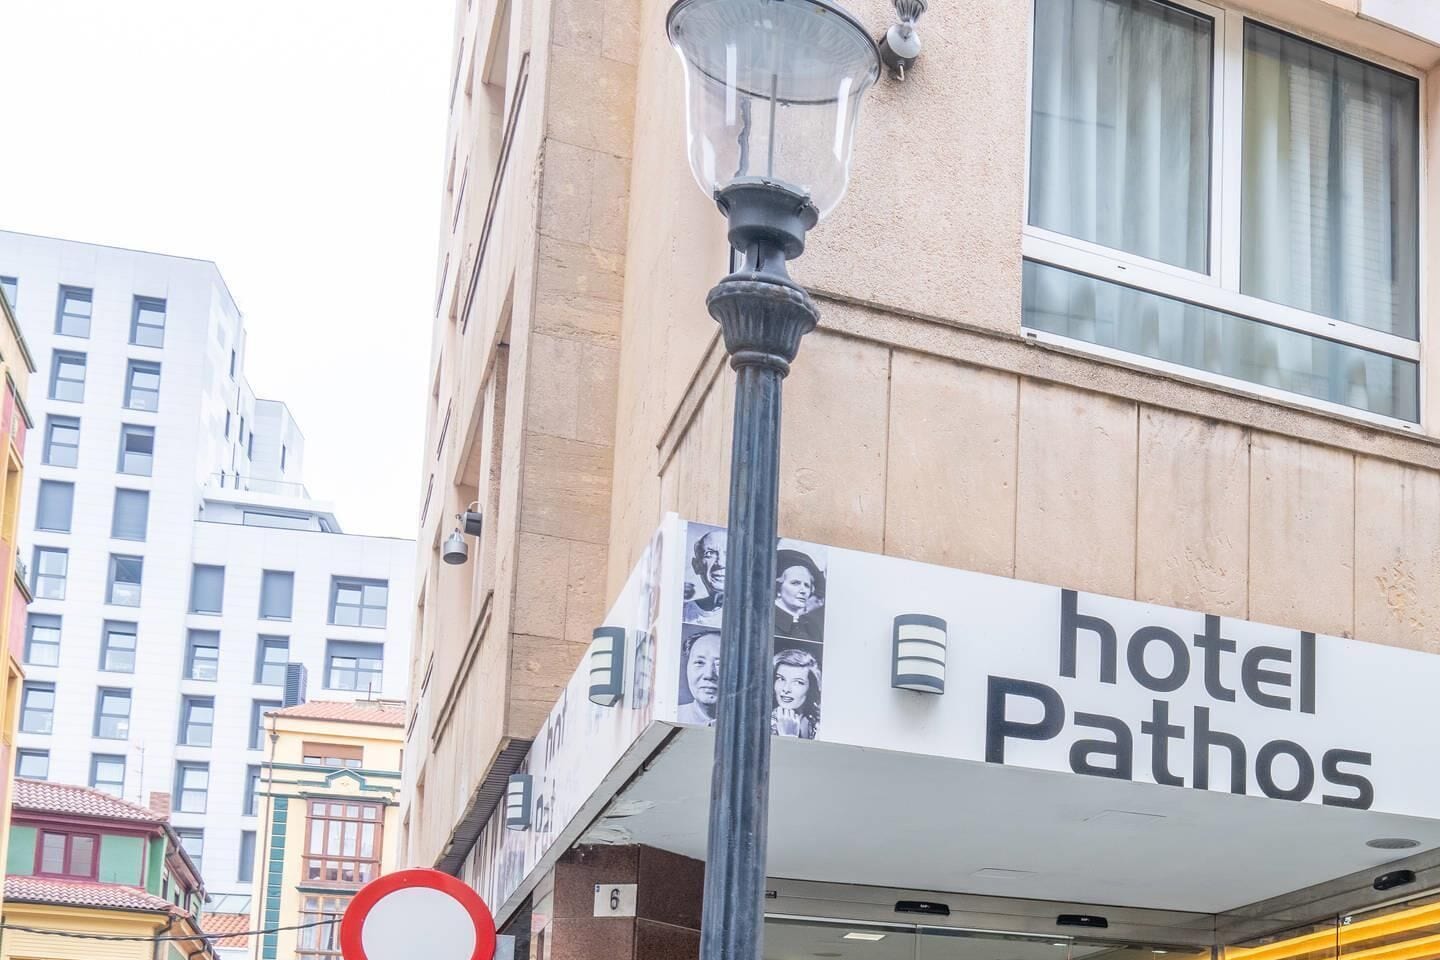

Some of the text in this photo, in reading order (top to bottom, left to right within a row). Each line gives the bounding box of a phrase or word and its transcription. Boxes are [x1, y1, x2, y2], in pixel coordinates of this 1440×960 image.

[1060, 589, 1316, 714] hotel
[986, 675, 1374, 810] Pathos
[610, 888, 621, 911] 6
